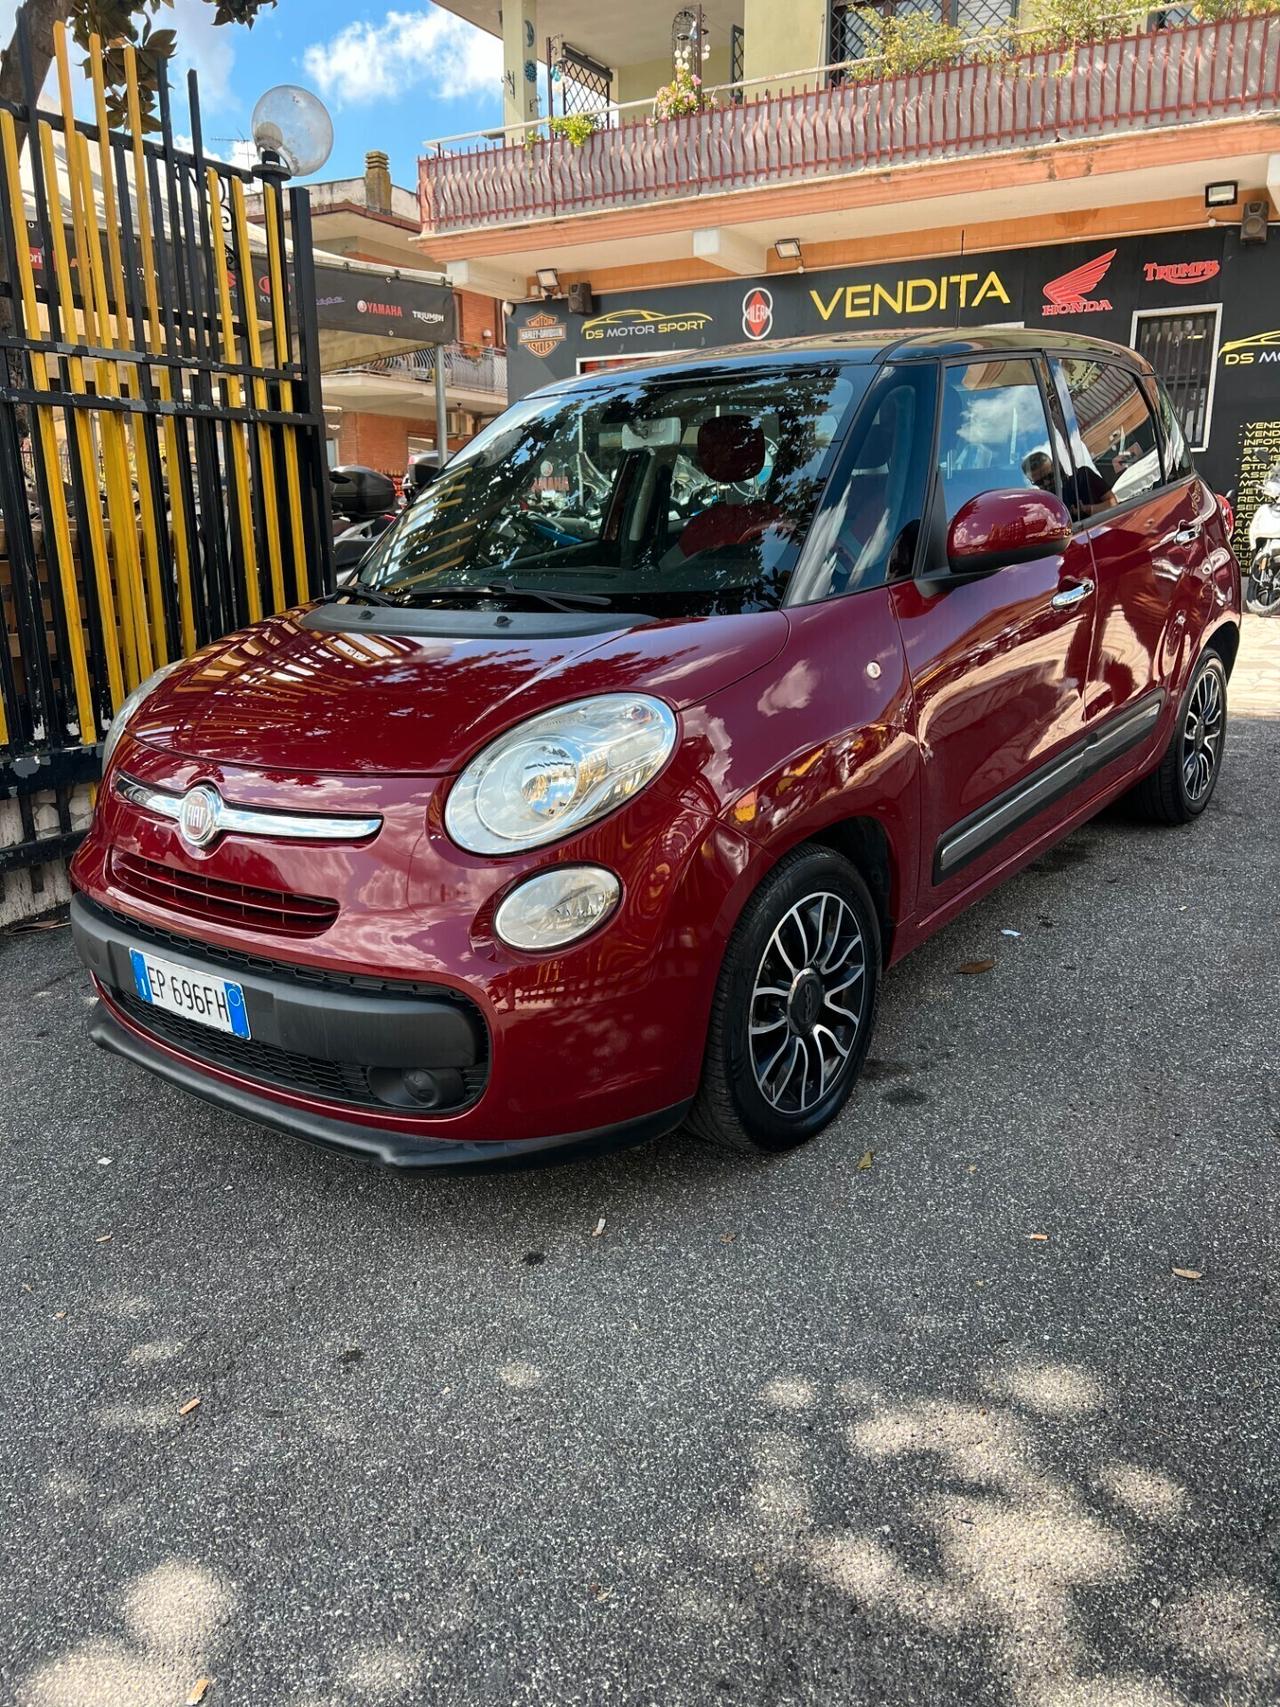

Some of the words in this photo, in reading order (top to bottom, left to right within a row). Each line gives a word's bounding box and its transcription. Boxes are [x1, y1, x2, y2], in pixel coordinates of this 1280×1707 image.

[1143, 260, 1220, 284] TRIUMPH
[809, 270, 1011, 321] VENDITA
[367, 302, 402, 317] YAMAHA
[412, 310, 444, 323] TRIUMPH
[1042, 299, 1113, 316] HONDA
[585, 328, 604, 340] DS
[606, 324, 656, 338] MOTOR
[657, 319, 706, 333] SPORT
[1225, 352, 1254, 365] DS
[147, 966, 165, 999] EP
[171, 976, 230, 1022] 696FH
